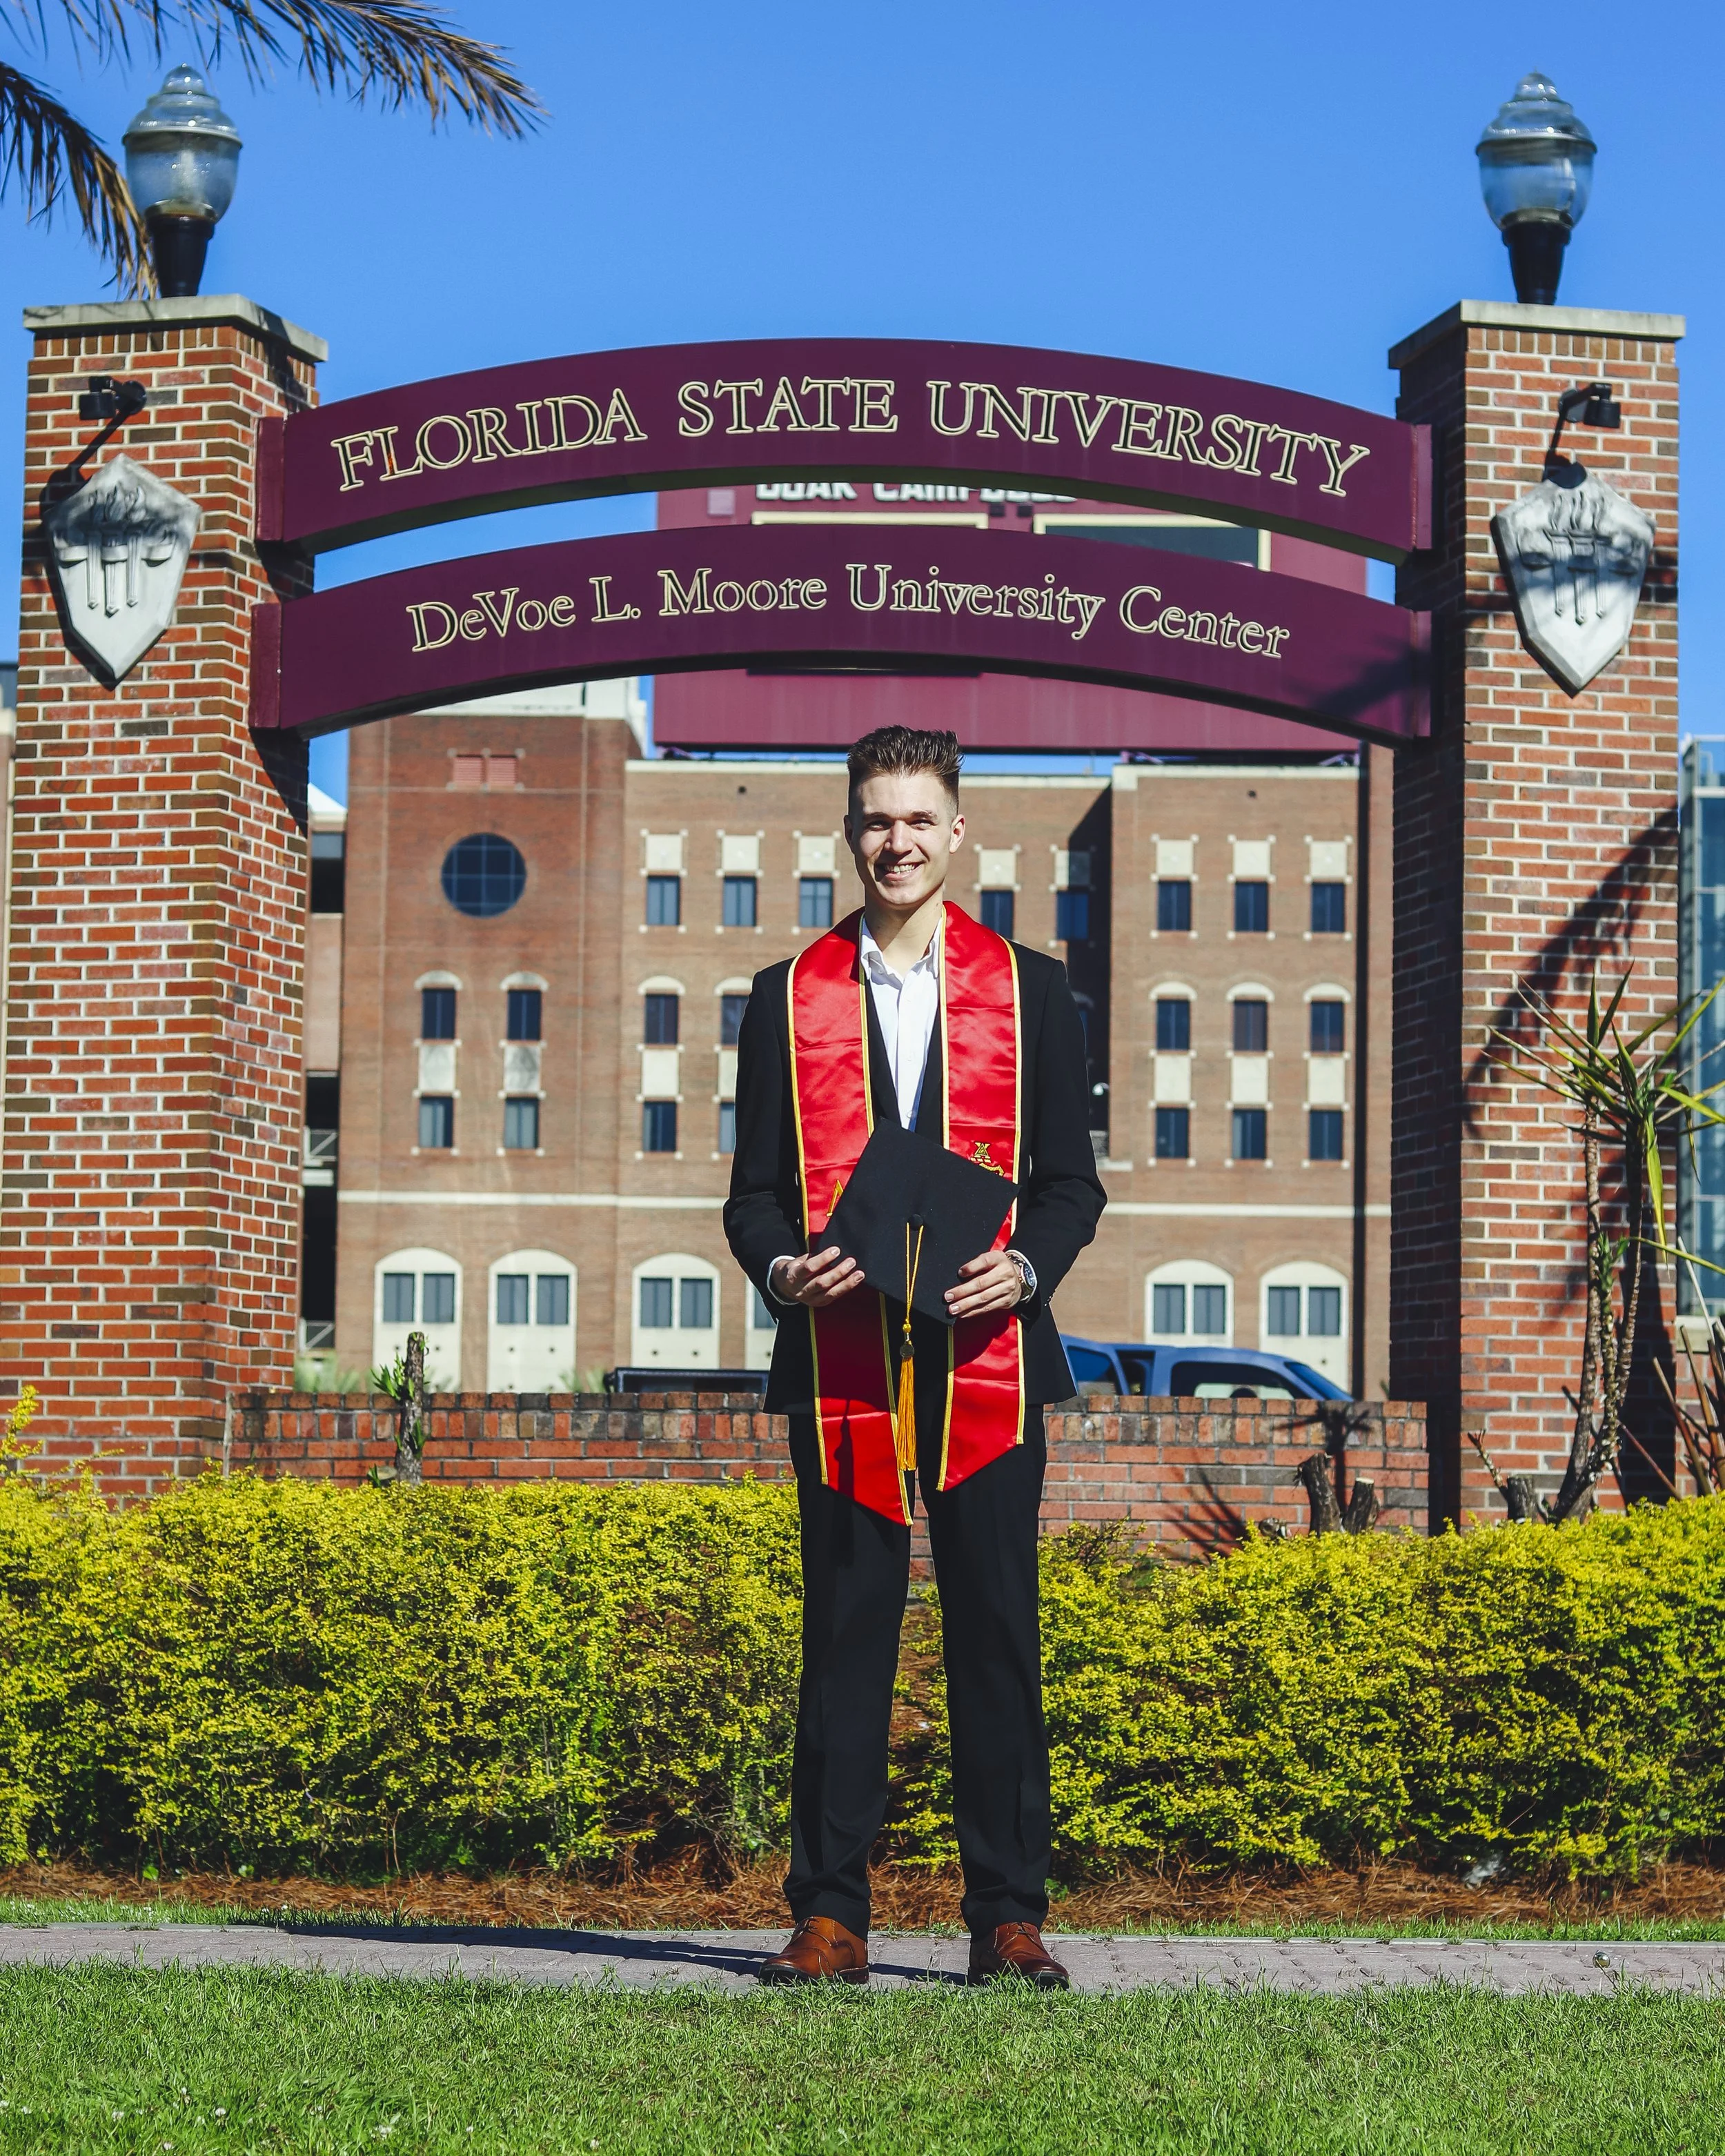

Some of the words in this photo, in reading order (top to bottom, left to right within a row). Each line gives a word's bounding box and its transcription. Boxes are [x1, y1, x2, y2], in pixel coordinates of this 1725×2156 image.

[331, 388, 648, 491] FLORIDA
[678, 376, 898, 437] STATE
[926, 380, 1370, 497] UNIVERSITY
[406, 588, 575, 651] DeVoe
[589, 576, 641, 622] L.
[658, 568, 827, 615] Moore
[845, 564, 1105, 640] University
[1119, 585, 1290, 658] Center
